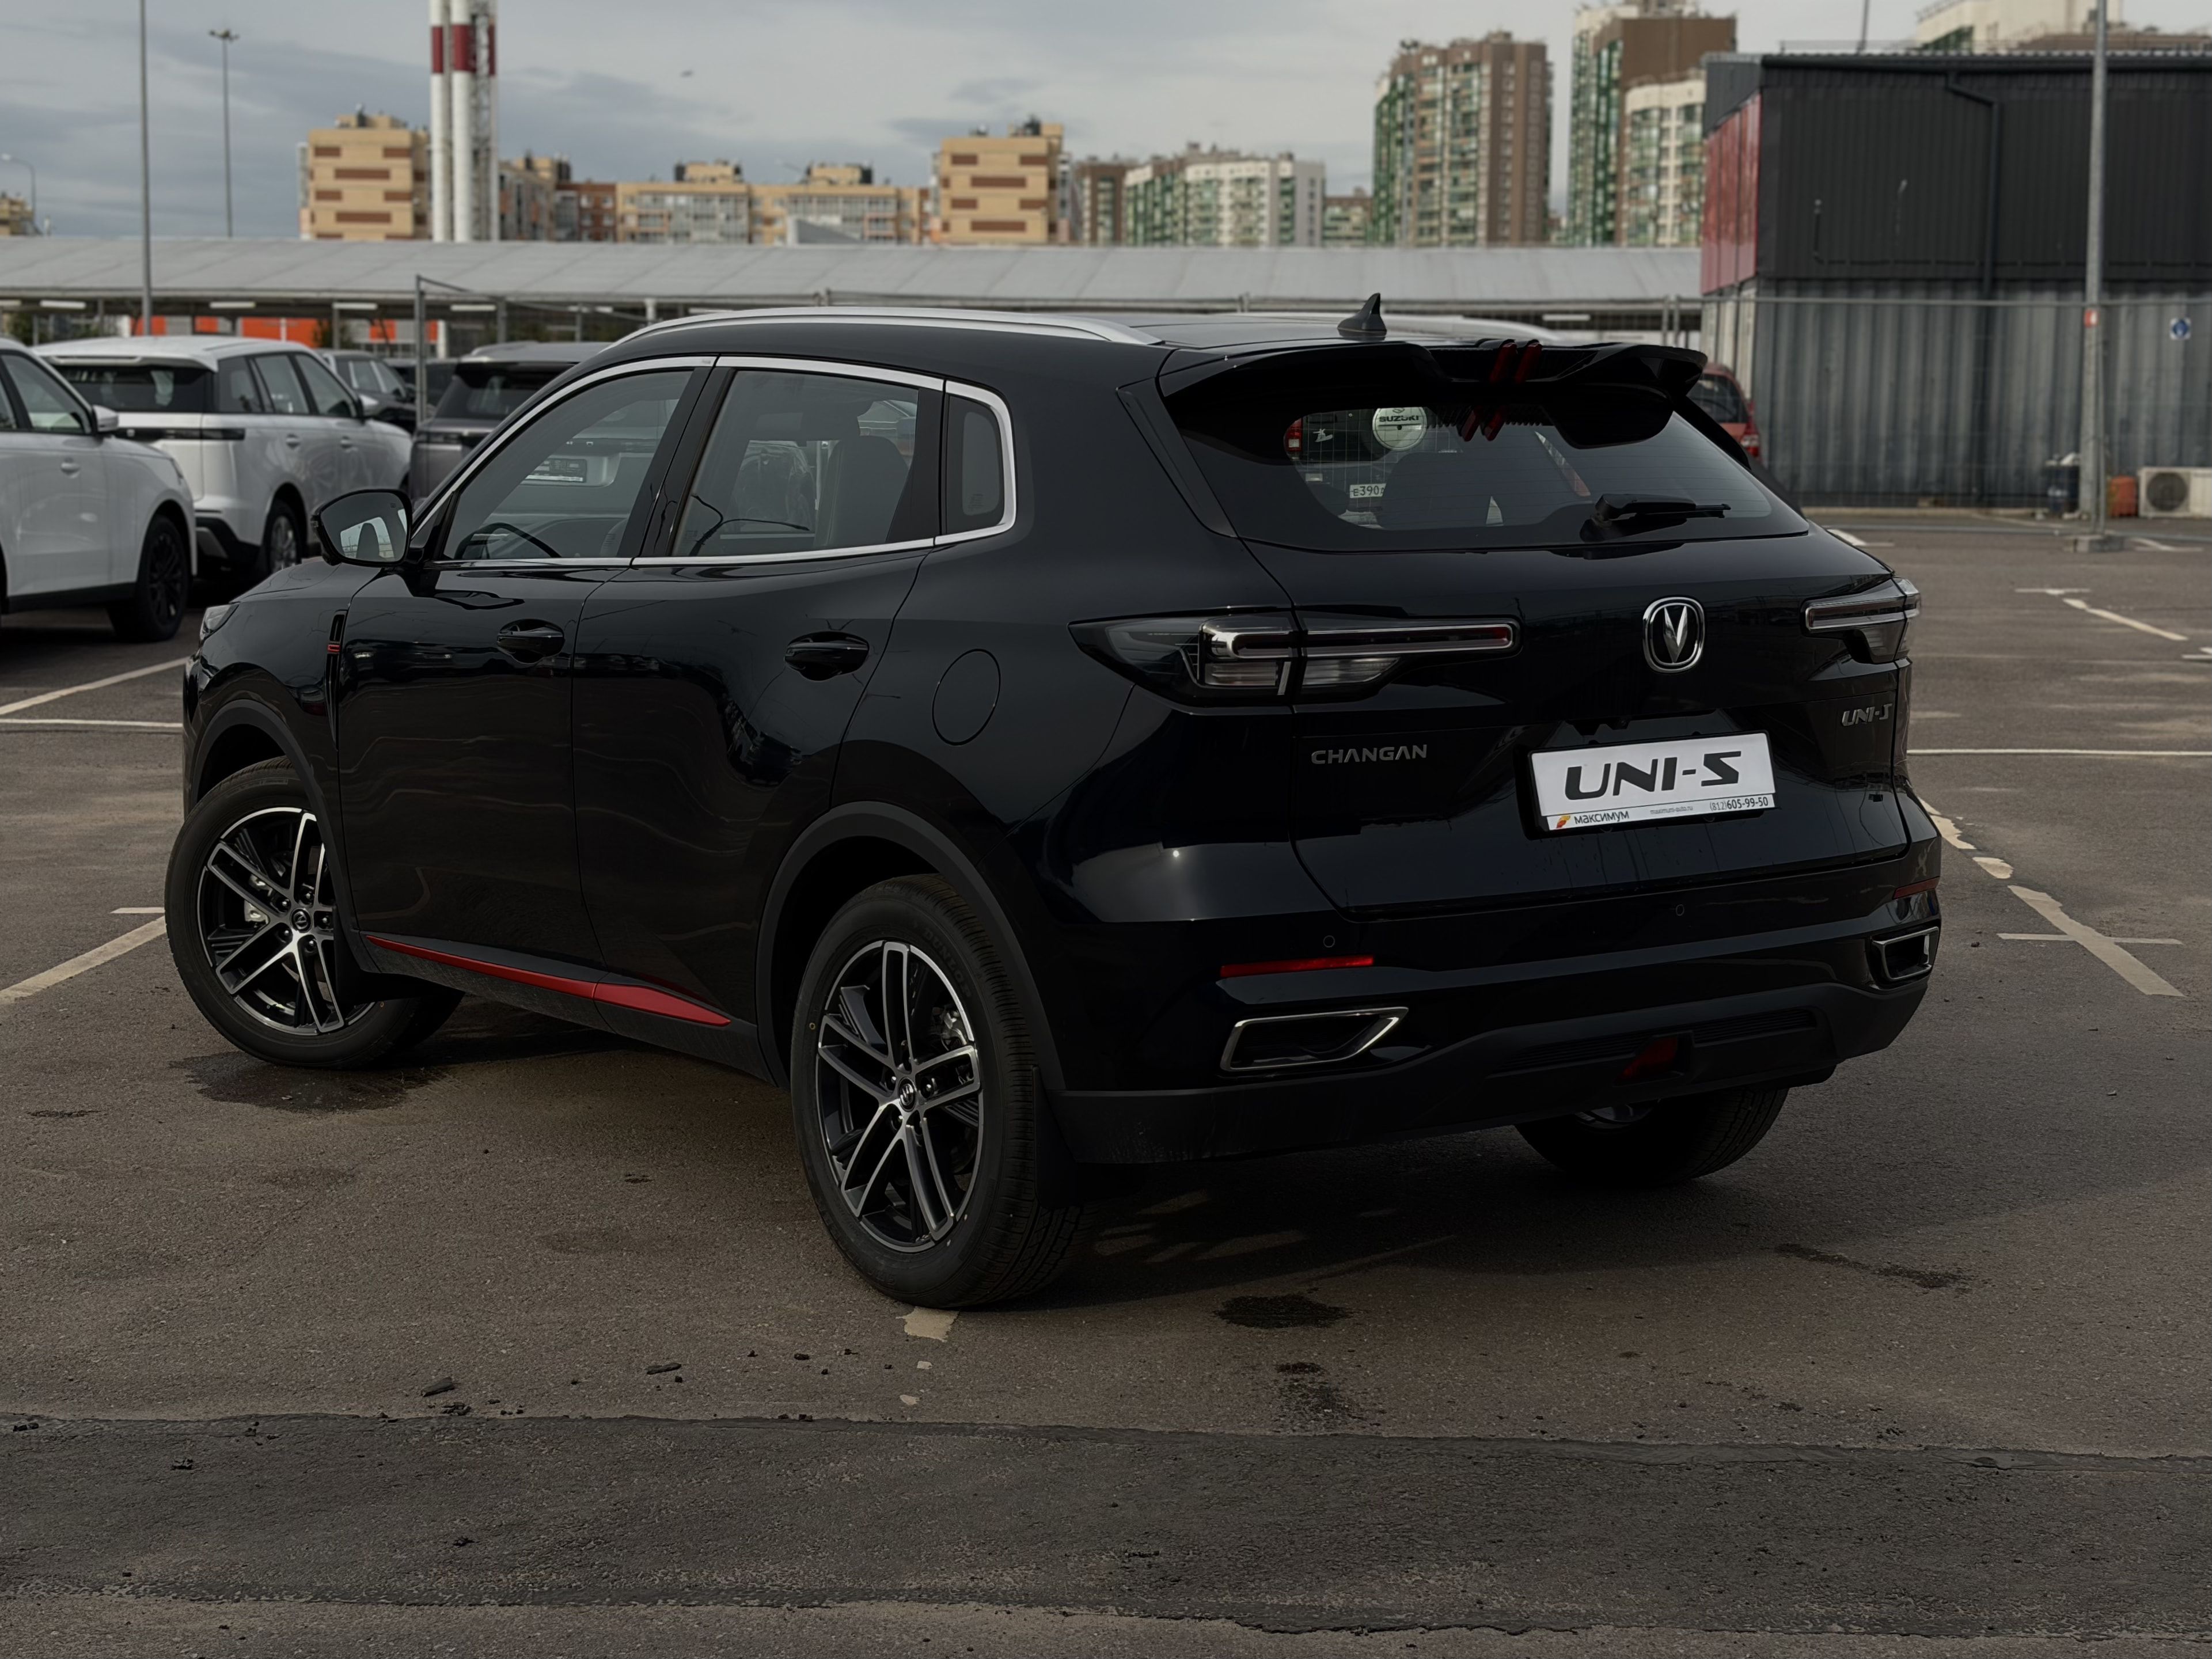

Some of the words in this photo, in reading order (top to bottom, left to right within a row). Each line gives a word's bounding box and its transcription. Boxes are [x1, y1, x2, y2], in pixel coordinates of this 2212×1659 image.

[1842, 703, 1893, 726] UNI-S
[1311, 743, 1428, 765] CHANGAN
[1565, 750, 1741, 800] UNI-S
[1709, 796, 1769, 812] (812)605-99-50
[921, 927, 972, 998] DUNLOP
